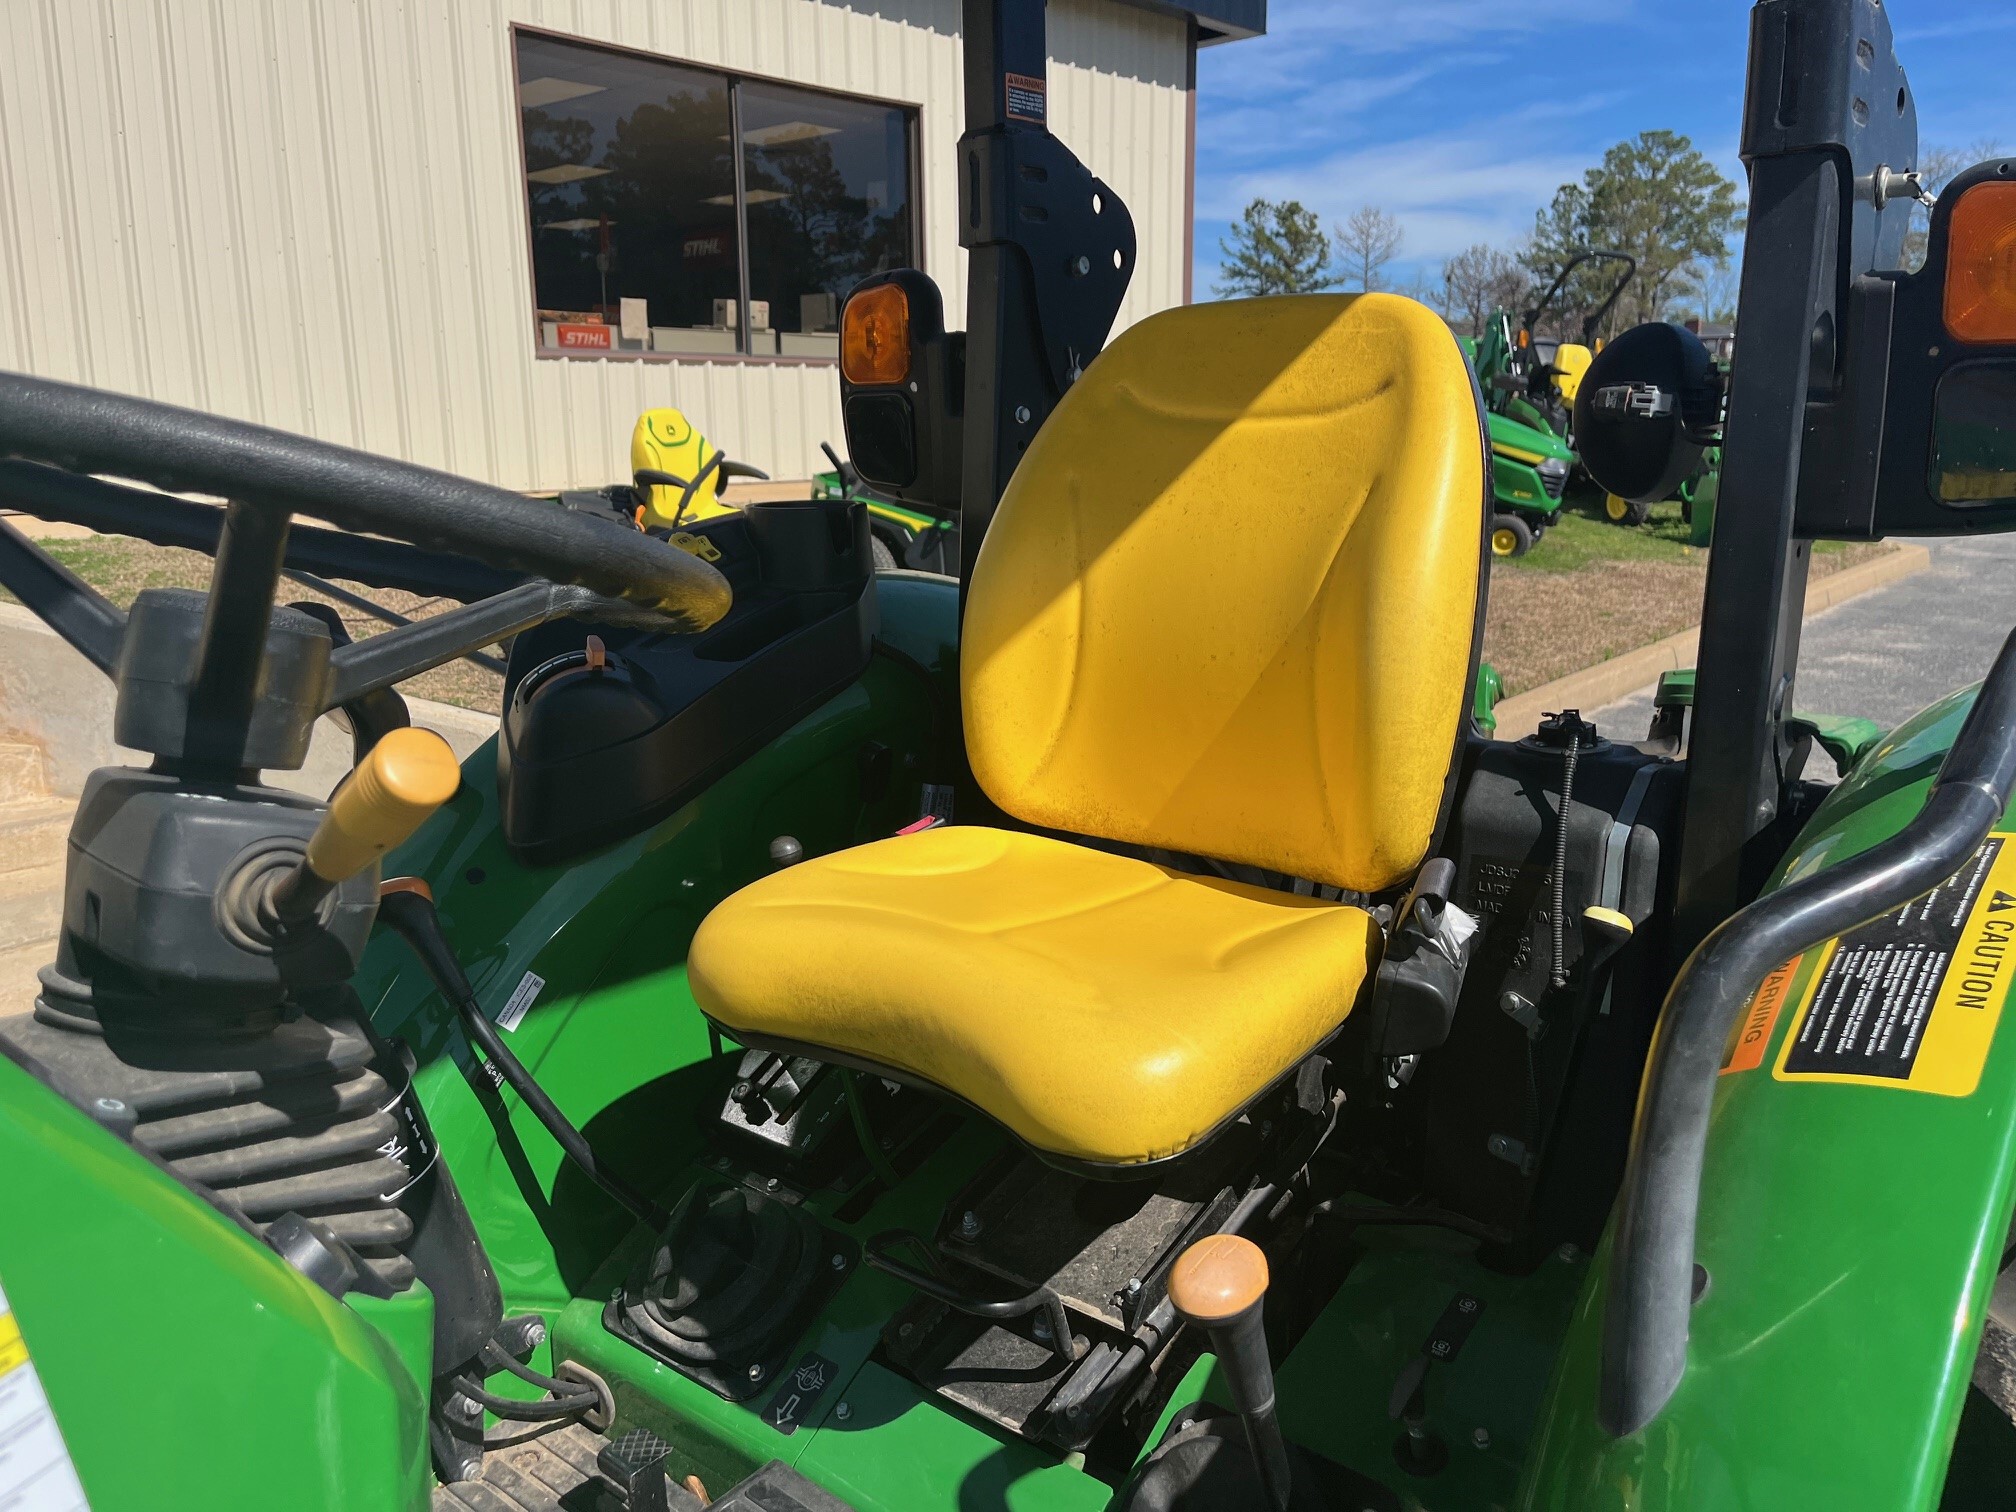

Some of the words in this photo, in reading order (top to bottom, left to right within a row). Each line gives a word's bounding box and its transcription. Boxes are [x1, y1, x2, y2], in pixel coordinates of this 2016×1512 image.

[1014, 76, 1045, 90] WARNING
[683, 239, 721, 257] STIHL
[564, 331, 608, 346] STIHL
[1954, 919, 2015, 1010] CAUTION
[499, 1000, 517, 1023] CANADA
